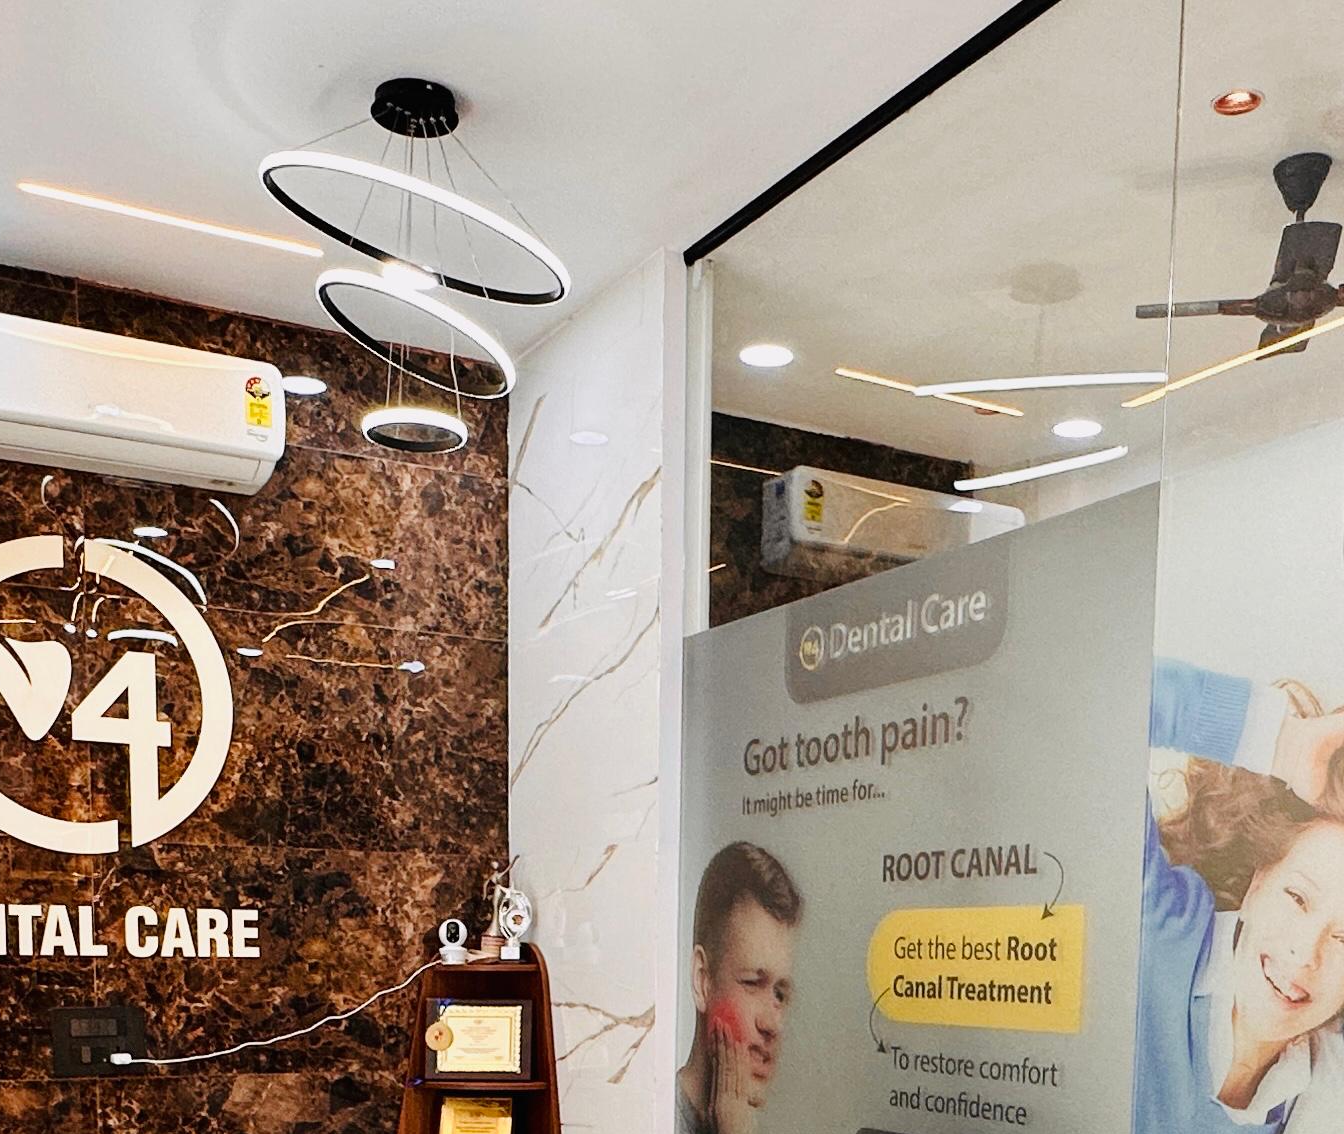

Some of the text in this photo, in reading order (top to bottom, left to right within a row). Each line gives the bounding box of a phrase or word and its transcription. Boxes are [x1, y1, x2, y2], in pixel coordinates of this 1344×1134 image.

[830, 599, 913, 660] Dental
[921, 590, 987, 634] Care
[744, 696, 969, 777] Got tooth pain?
[741, 795, 751, 815] It
[753, 787, 793, 817] might
[795, 787, 814, 809] be
[815, 781, 849, 806] time
[882, 843, 1038, 883] ROOT CANAL
[124, 905, 261, 958] CARE
[893, 936, 1057, 962] Get the best Root
[893, 975, 1052, 1005] Canal Treatment
[890, 1046, 1058, 1087] To restore comfort
[889, 1086, 1027, 1126] and confidence
